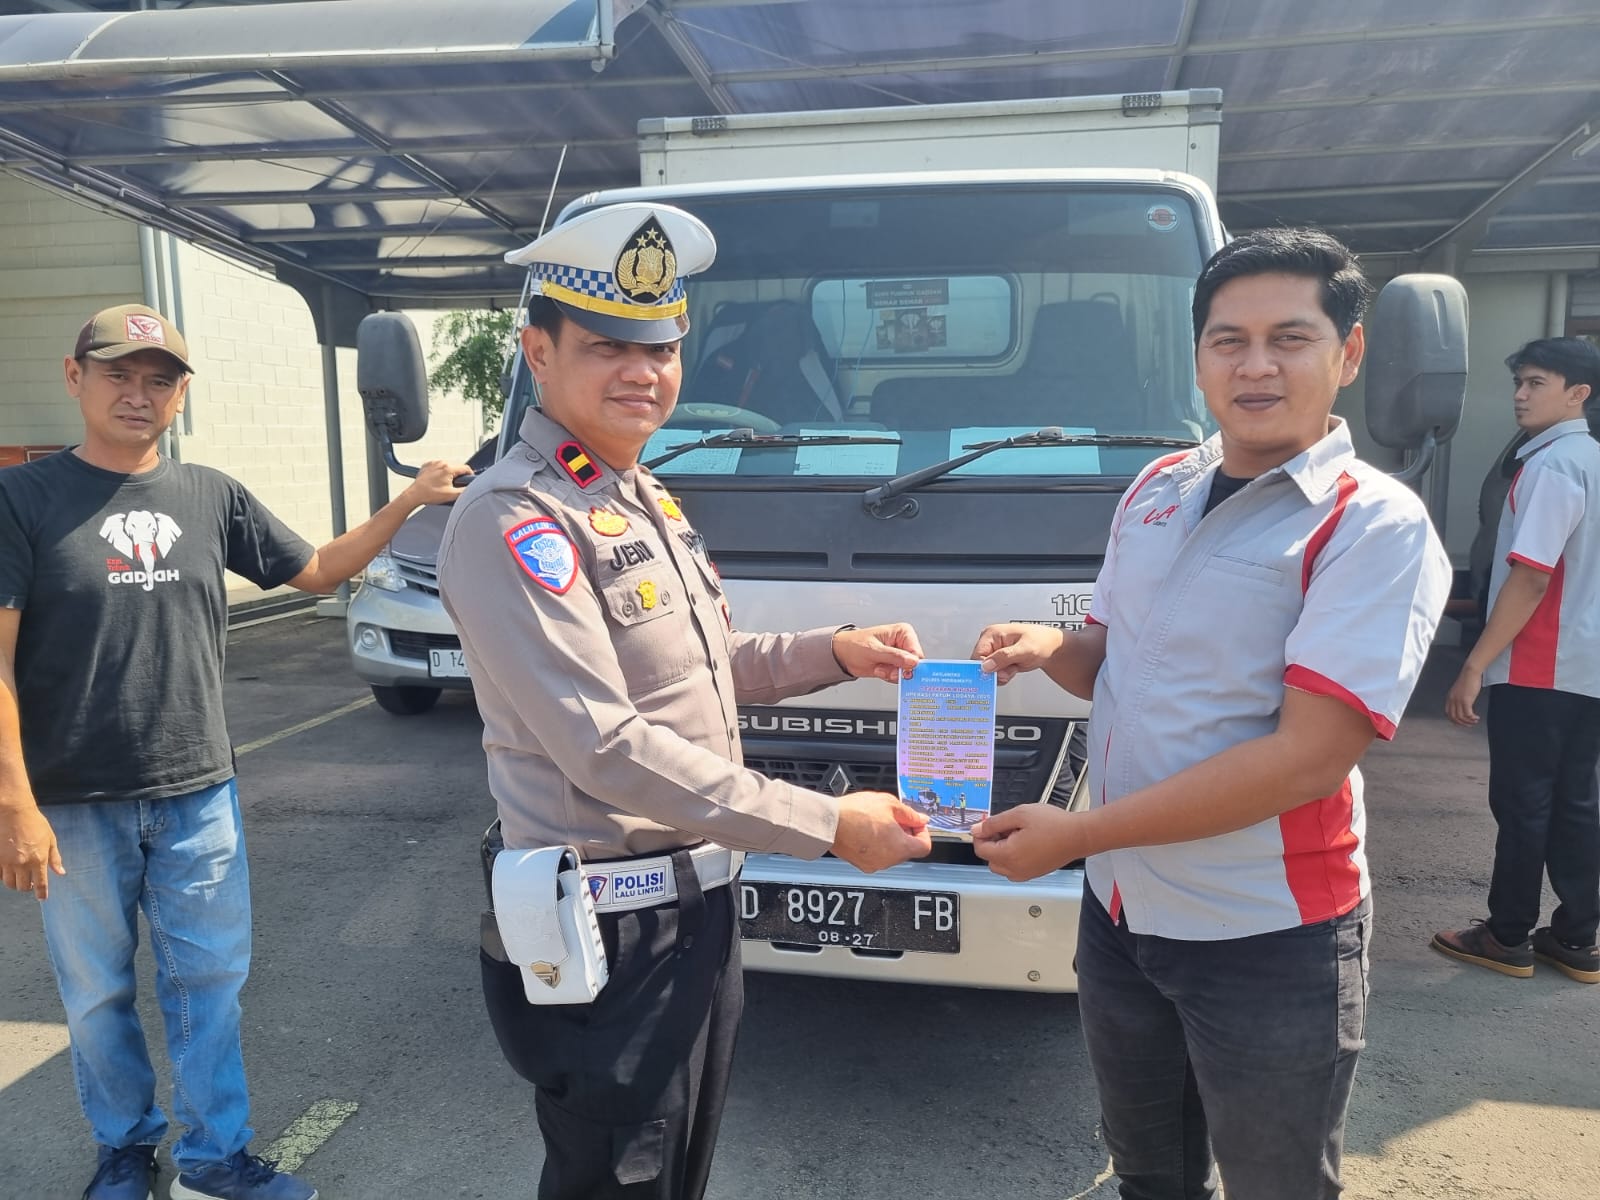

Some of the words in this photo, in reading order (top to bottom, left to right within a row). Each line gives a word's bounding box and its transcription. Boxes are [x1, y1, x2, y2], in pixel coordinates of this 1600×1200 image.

[432, 651, 441, 668] D
[615, 872, 664, 891] POLISI
[615, 890, 636, 898] LALU
[637, 886, 664, 896] LINTAS
[741, 886, 760, 920] D
[787, 888, 865, 926] 8927
[914, 895, 954, 932] FB
